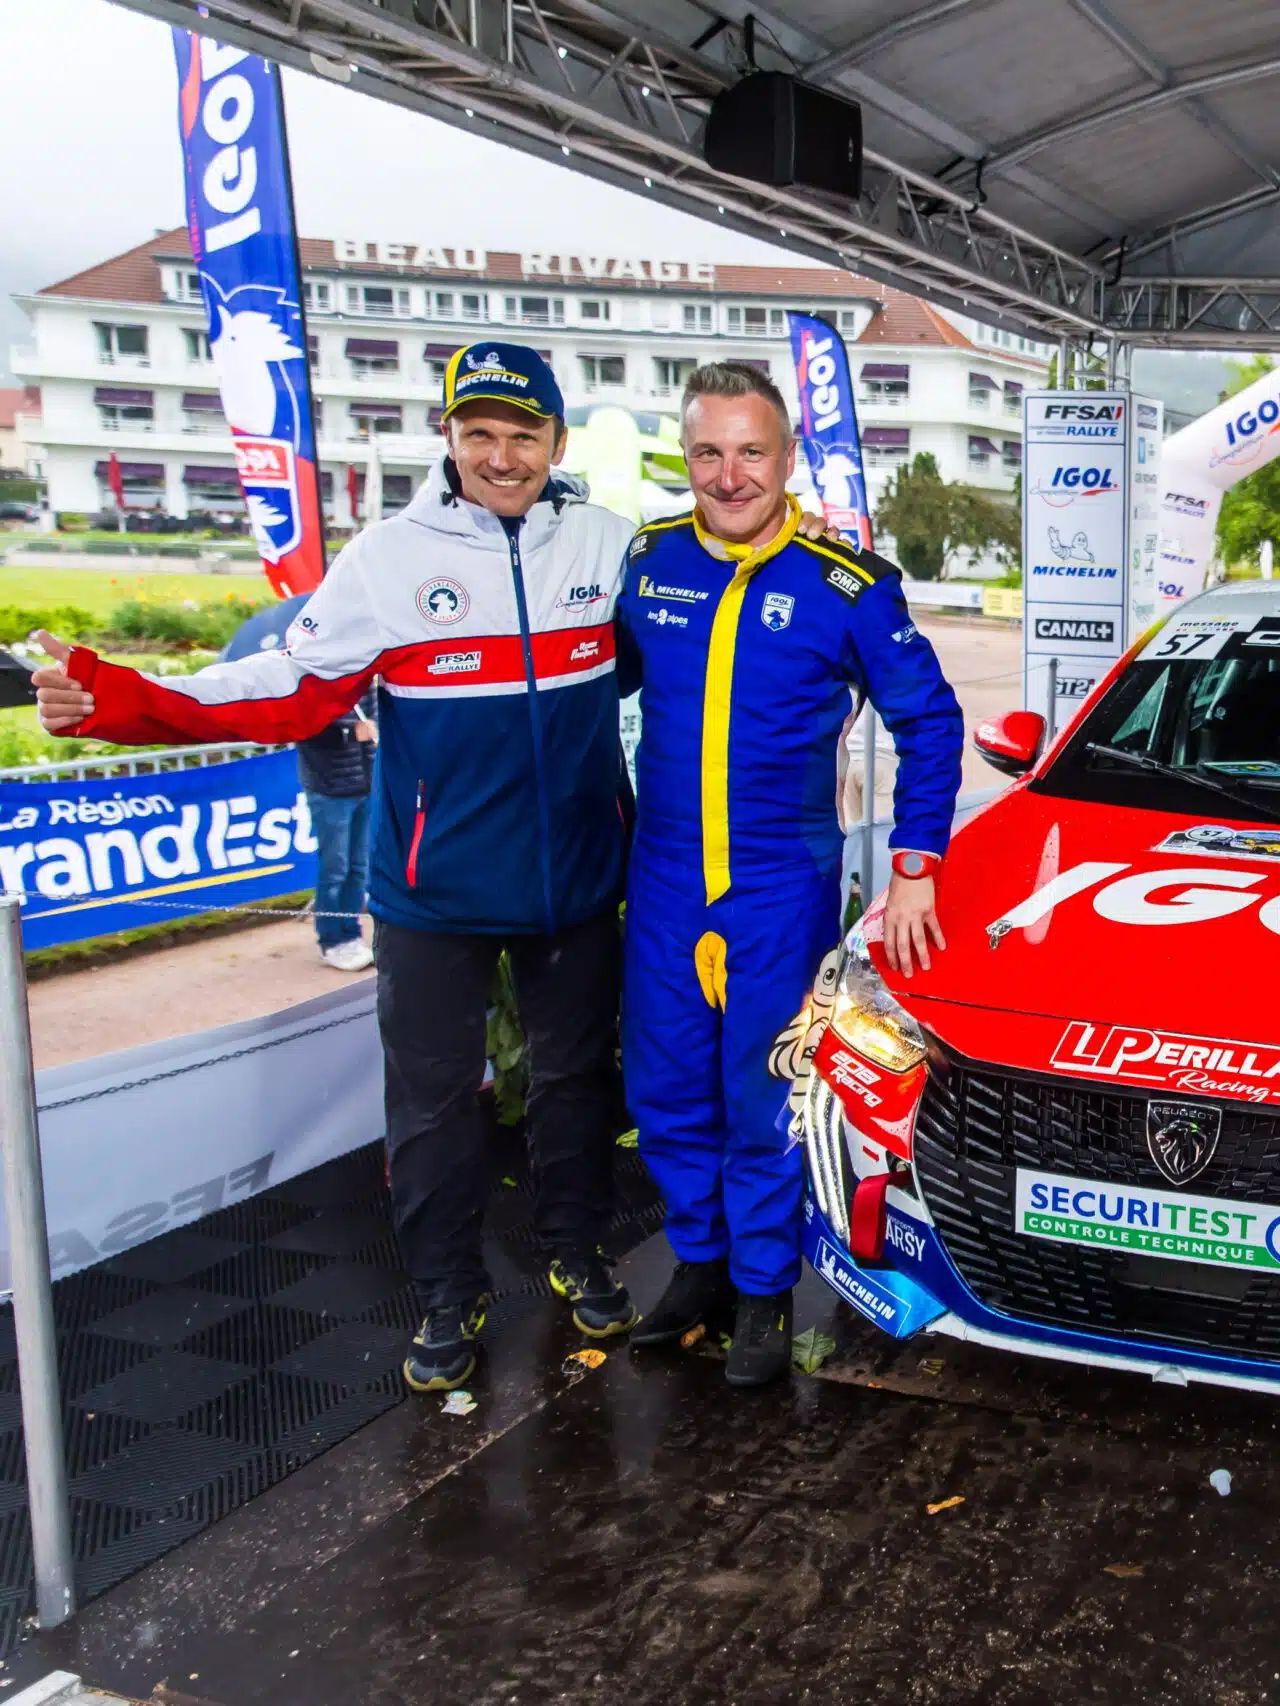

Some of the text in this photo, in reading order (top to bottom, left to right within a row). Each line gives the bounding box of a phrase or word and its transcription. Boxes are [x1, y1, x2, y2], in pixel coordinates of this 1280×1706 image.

[333, 239, 716, 285] BEAU RIVAGE
[456, 374, 530, 389] MICHELIN
[1066, 426, 1118, 437] RALLYE
[1051, 467, 1113, 488] IGOL
[830, 570, 861, 593] OMP
[1033, 565, 1118, 578] MICHELIN
[570, 584, 603, 601] IGOL
[657, 585, 710, 600] MICHELIN
[1159, 580, 1185, 598] OL
[770, 597, 789, 606] IGOL
[1037, 620, 1113, 641] CANAL+
[1155, 633, 1216, 657] 57
[448, 664, 478, 672] RALLYE
[48, 793, 175, 826] Région
[0, 804, 200, 907] rand
[830, 1050, 882, 1085] 208
[829, 1066, 883, 1109] Racing
[1167, 1069, 1272, 1103] Racing
[1153, 1106, 1214, 1121] PEUGEOT
[1029, 1182, 1258, 1240] SECURITEST
[885, 1221, 927, 1262] ARSY
[1027, 1215, 1256, 1262] CONTROLE TECHNIQUE
[835, 1267, 897, 1321] MICHELIN
